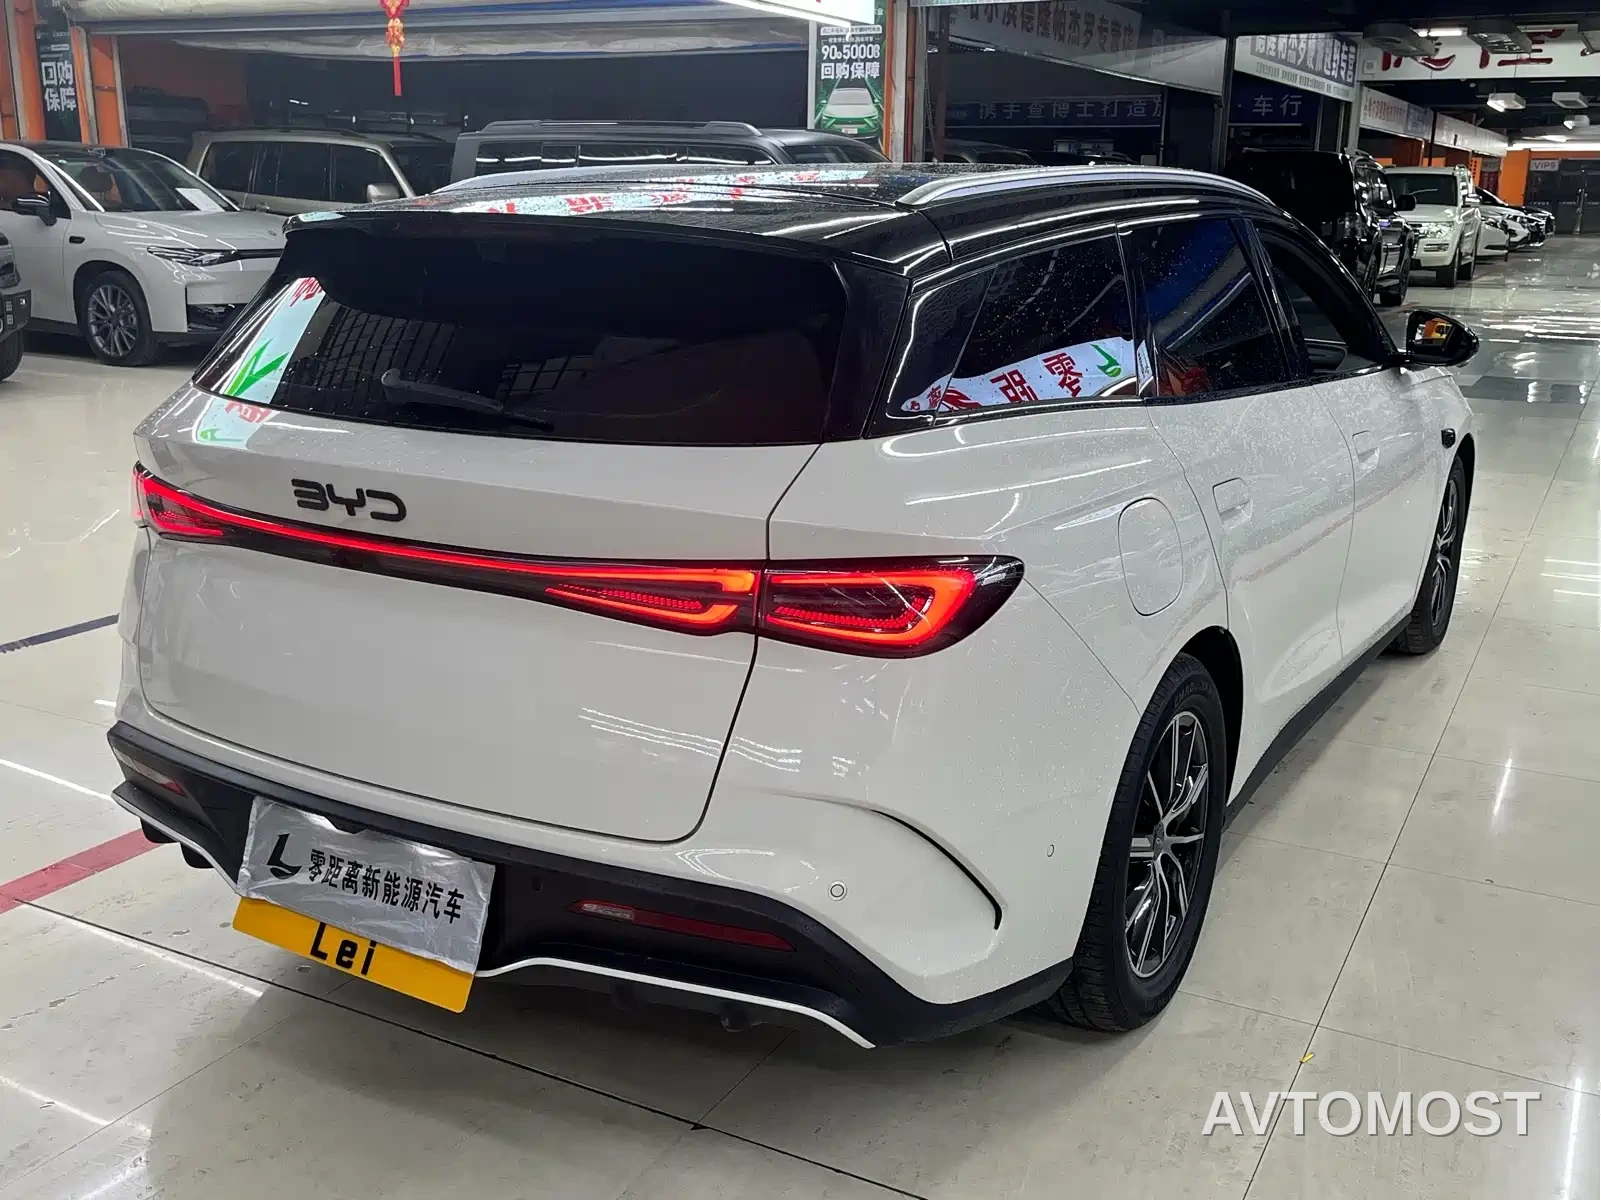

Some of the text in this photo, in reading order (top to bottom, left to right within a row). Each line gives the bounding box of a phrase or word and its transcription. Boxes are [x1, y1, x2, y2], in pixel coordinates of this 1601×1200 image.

[41, 60, 73, 87] 回购
[821, 62, 880, 80] 回购保障
[44, 87, 77, 112] 保障
[1252, 94, 1303, 117] 车行
[1534, 161, 1556, 169] VIP9
[291, 478, 407, 522] BYD
[308, 848, 464, 924] 零距离新能源汽车
[310, 922, 376, 976] Lei
